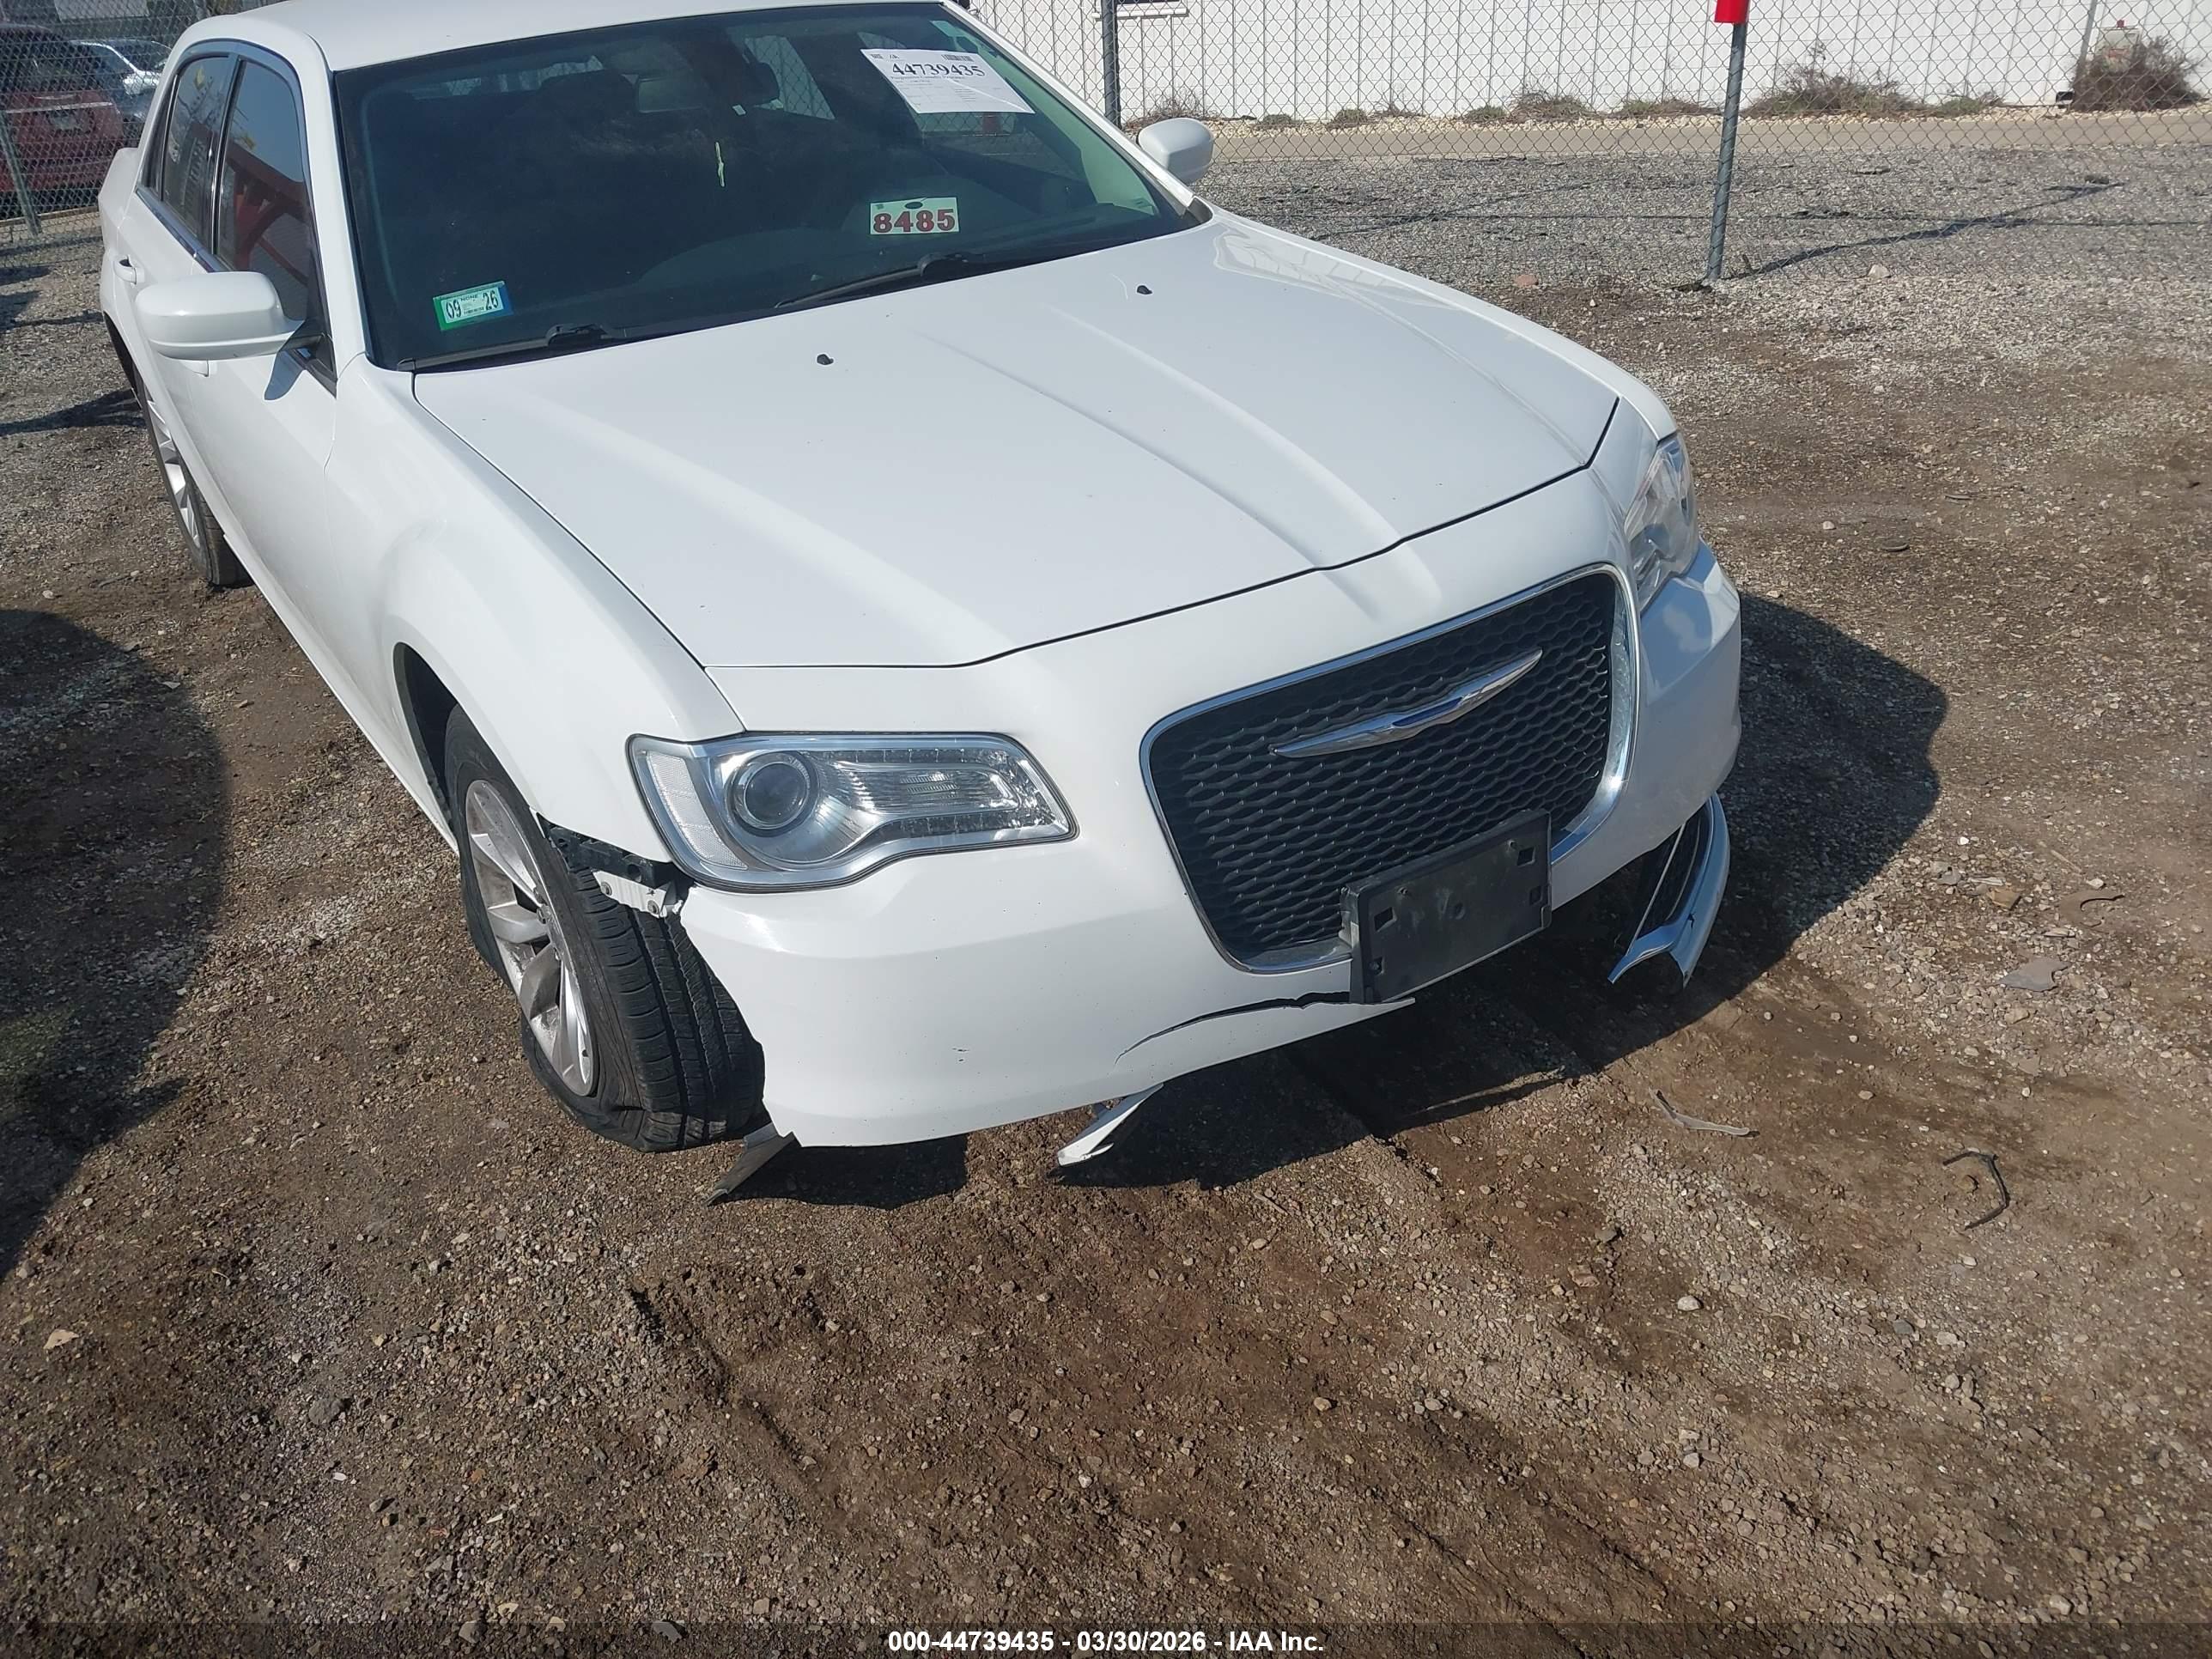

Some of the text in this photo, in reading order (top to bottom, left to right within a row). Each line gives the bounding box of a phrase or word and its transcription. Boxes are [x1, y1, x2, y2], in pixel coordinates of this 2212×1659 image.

[892, 63, 986, 76] 44739435
[872, 209, 956, 234] 8485
[446, 298, 462, 319] 09
[483, 289, 499, 311] 26
